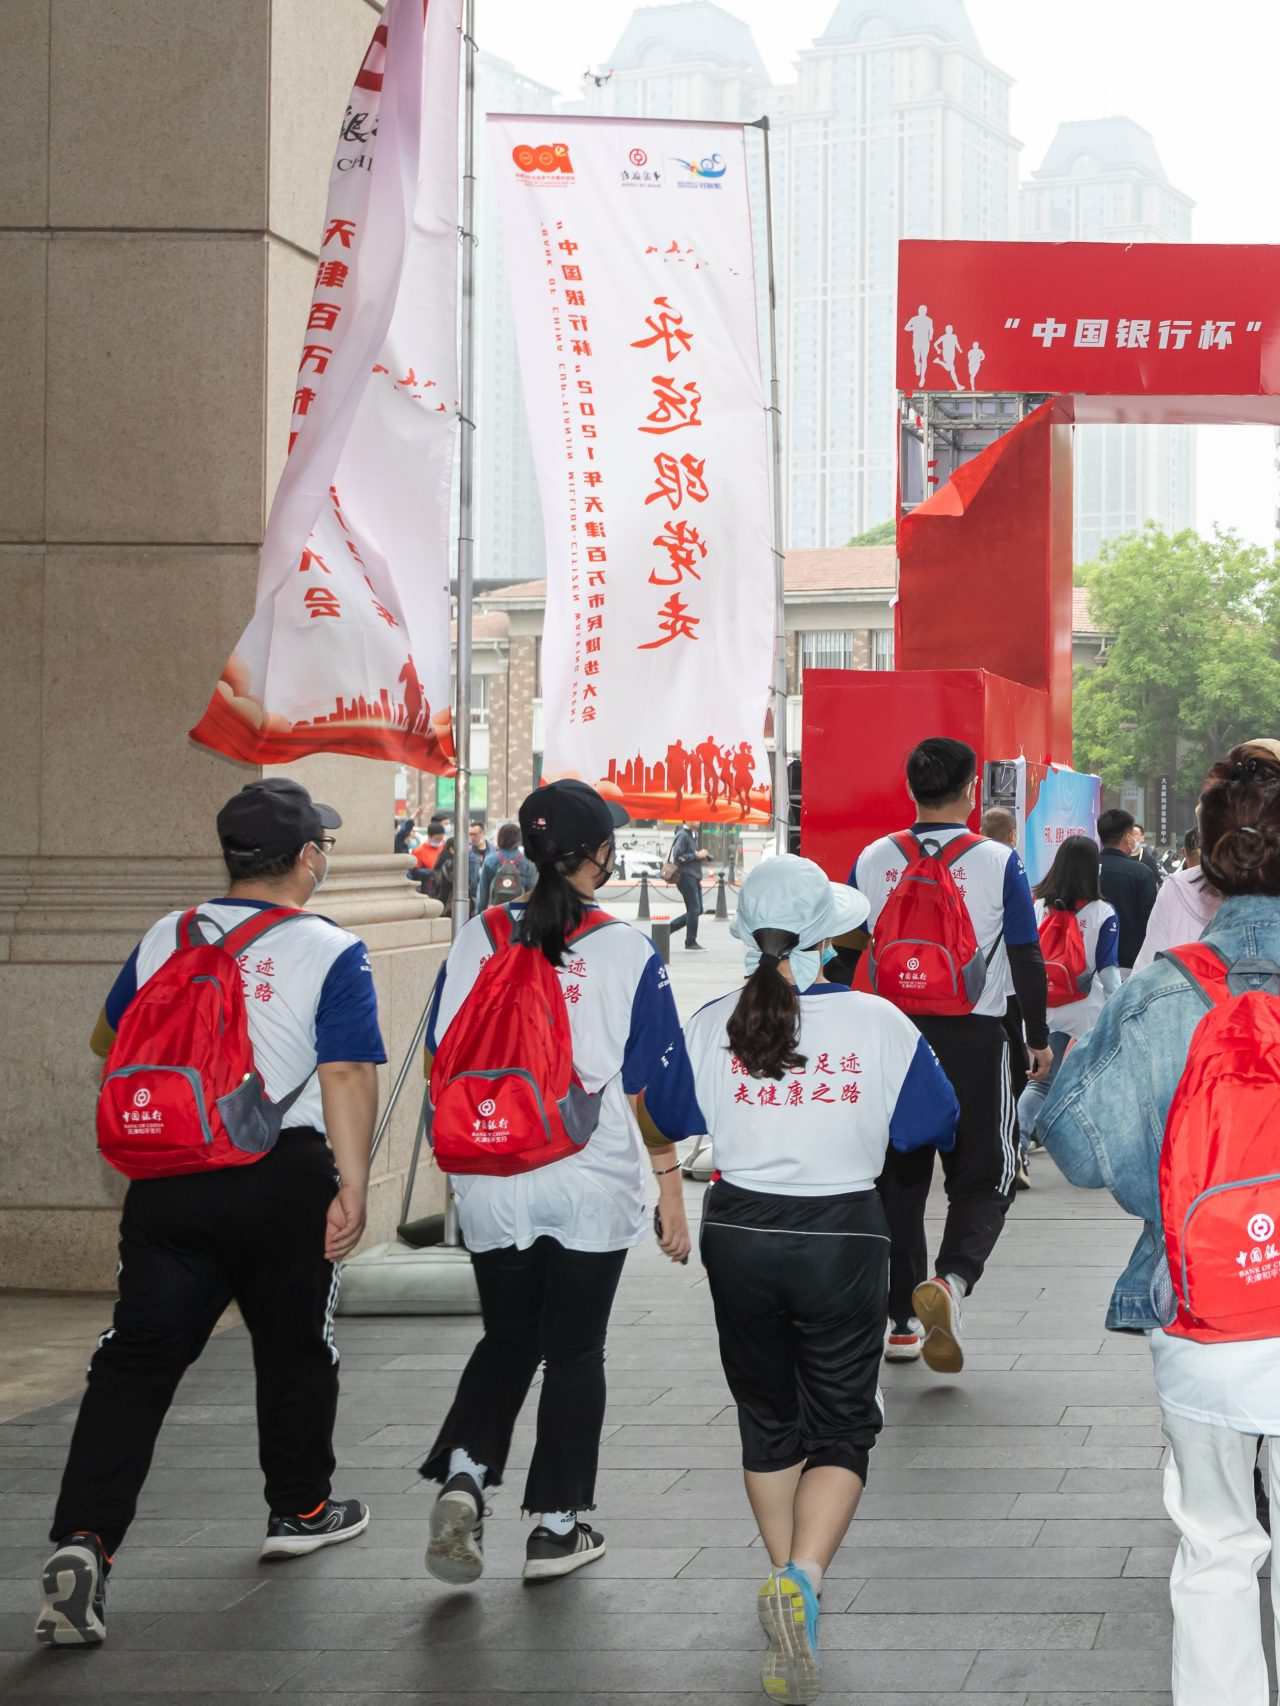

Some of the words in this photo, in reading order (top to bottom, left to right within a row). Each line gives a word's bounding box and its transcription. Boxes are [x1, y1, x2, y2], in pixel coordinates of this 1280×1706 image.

[733, 1079, 862, 1107] 走健康之路
[122, 1109, 163, 1123] 中国银行
[472, 1117, 510, 1131] 中国银行
